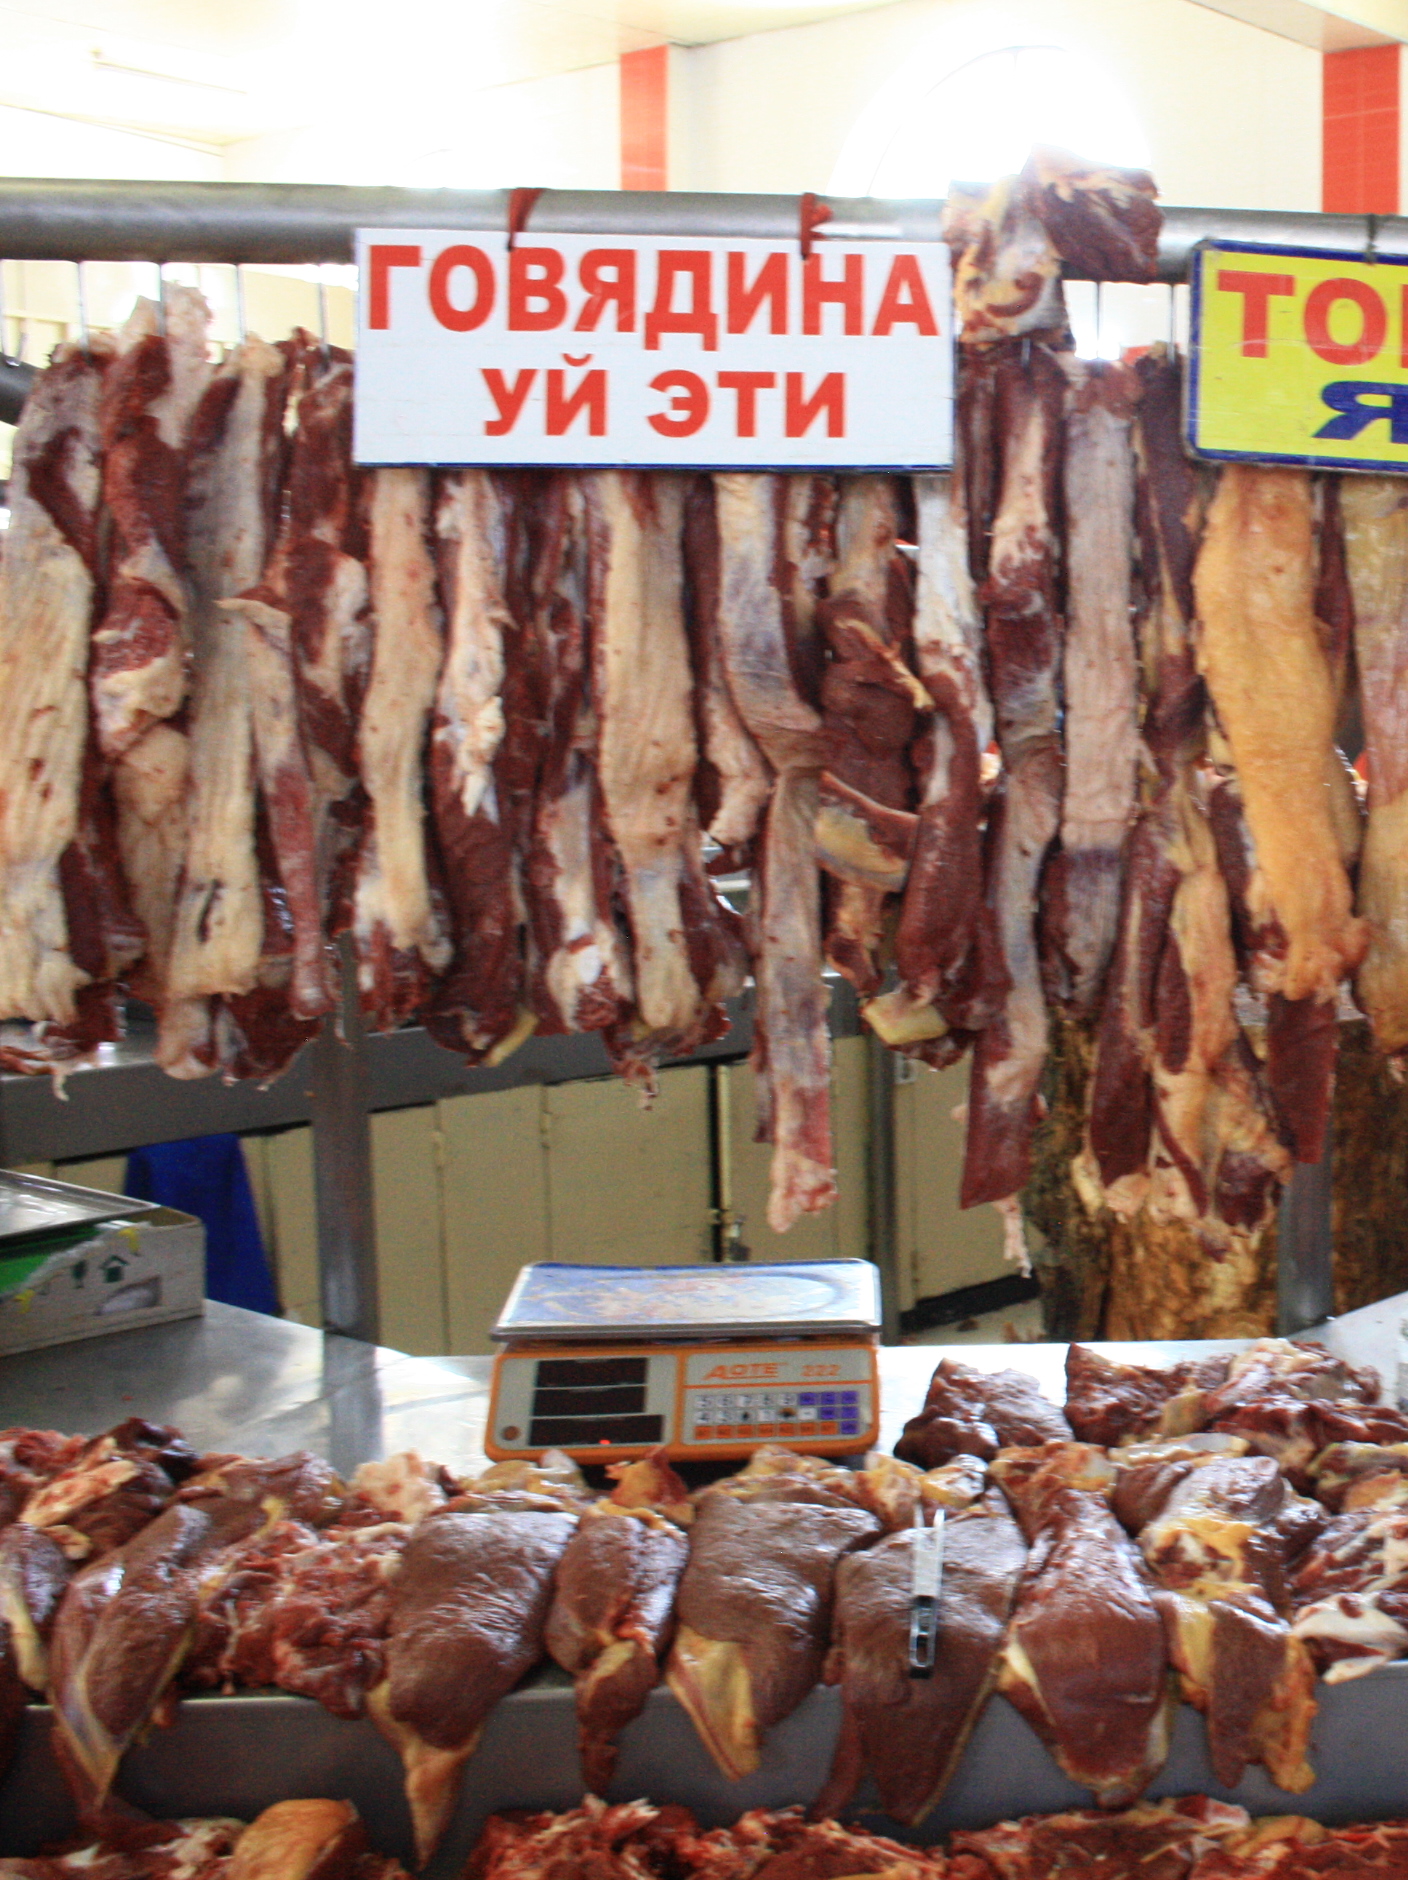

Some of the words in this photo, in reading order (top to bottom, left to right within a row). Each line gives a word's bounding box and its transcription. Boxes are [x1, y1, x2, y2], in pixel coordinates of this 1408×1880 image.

[368, 244, 940, 352] ГОВЯДИНА
[481, 353, 608, 437] УЙ
[646, 369, 848, 438] ЭТИ
